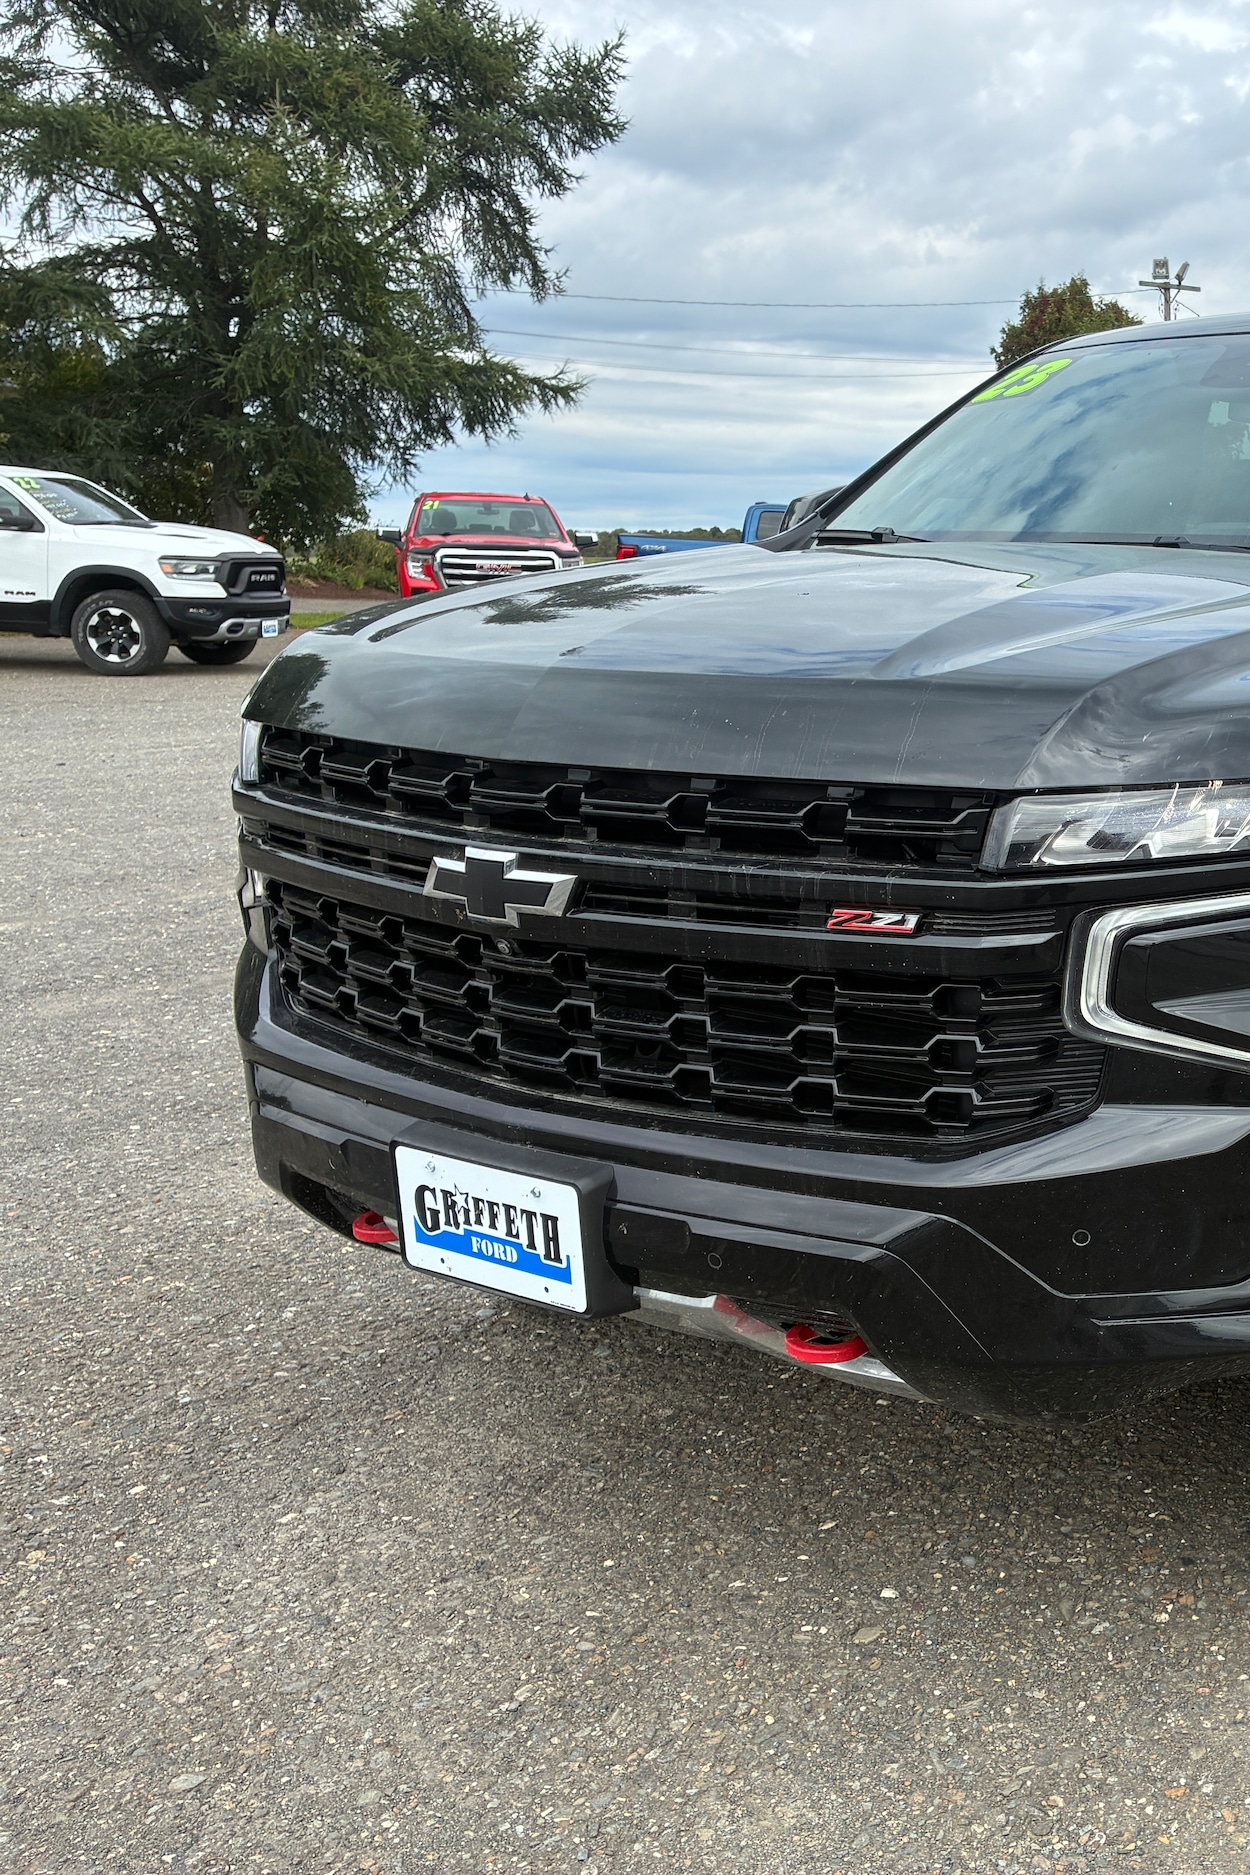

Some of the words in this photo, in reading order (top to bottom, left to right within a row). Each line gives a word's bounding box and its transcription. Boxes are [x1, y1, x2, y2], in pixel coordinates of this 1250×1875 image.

[971, 358, 1073, 403] 23
[13, 477, 41, 489] 22
[422, 500, 440, 510] 21
[250, 573, 276, 582] RAM
[827, 908, 920, 934] Z71
[470, 1235, 519, 1263] FORD
